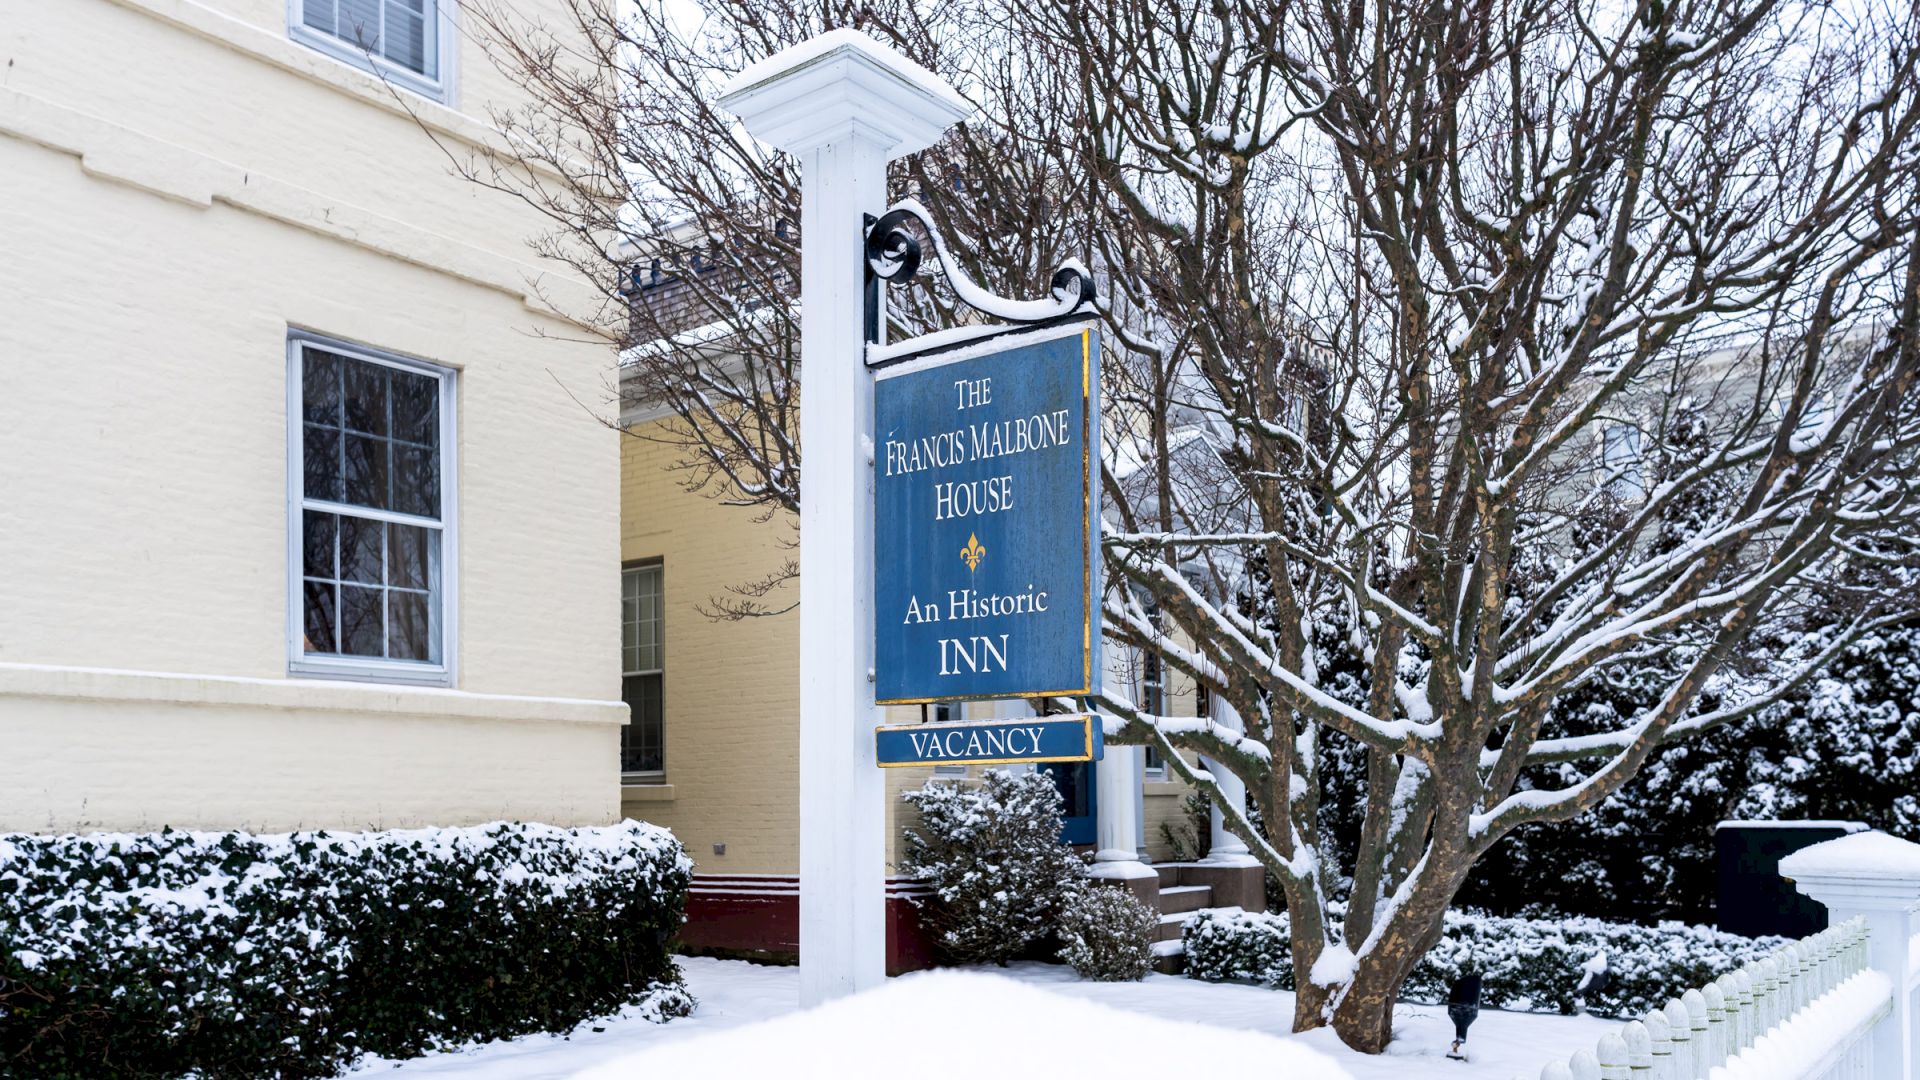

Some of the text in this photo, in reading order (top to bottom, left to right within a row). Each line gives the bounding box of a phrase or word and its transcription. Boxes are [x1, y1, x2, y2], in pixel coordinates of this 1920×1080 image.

[954, 377, 992, 410] THE
[885, 409, 1070, 477] FRANCIS MALBONE
[934, 475, 1014, 521] HOUSE
[903, 584, 1048, 625] An Historic
[937, 634, 1009, 676] INN
[909, 727, 1045, 758] VACANCY
